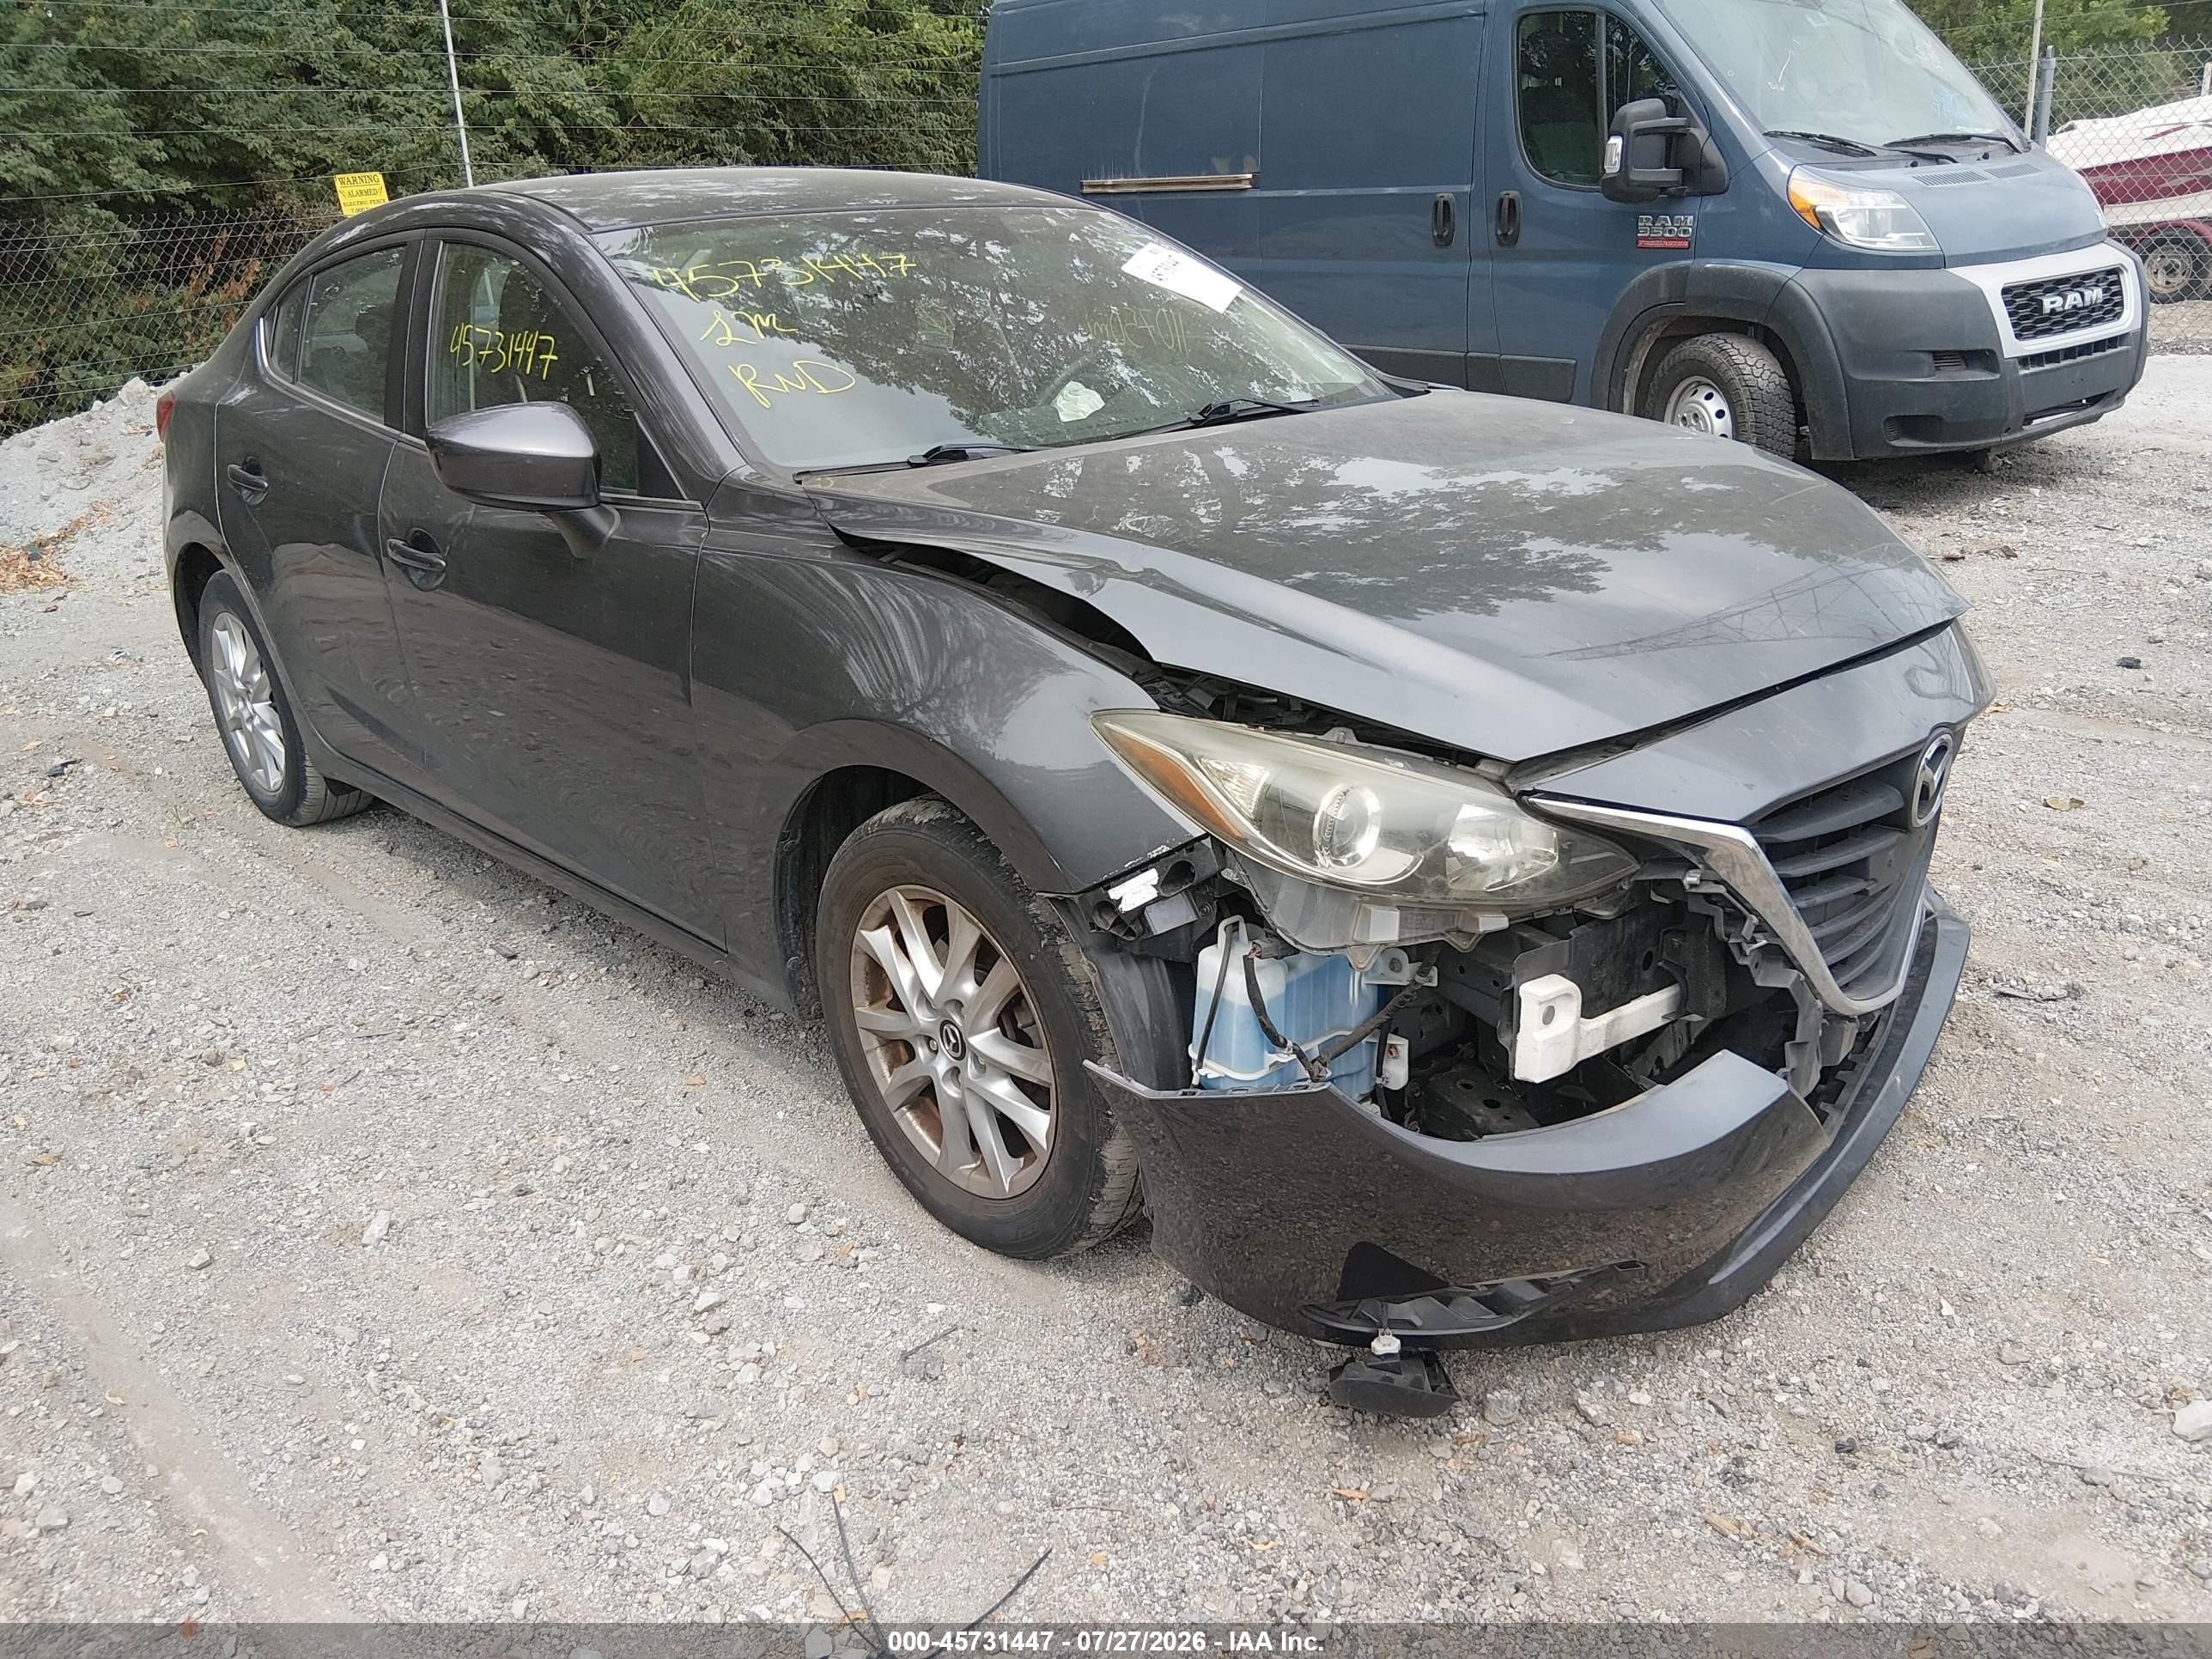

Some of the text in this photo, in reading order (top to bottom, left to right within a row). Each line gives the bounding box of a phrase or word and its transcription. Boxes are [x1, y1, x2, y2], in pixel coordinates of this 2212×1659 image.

[337, 174, 380, 185] WARNING
[347, 188, 379, 198] ALARMED
[1638, 215, 1693, 226] RAM
[1637, 226, 1692, 238] 3500
[653, 252, 917, 303] 45731447
[2037, 286, 2104, 316] RAM
[450, 323, 558, 380] 45731447
[728, 361, 856, 409] RND
